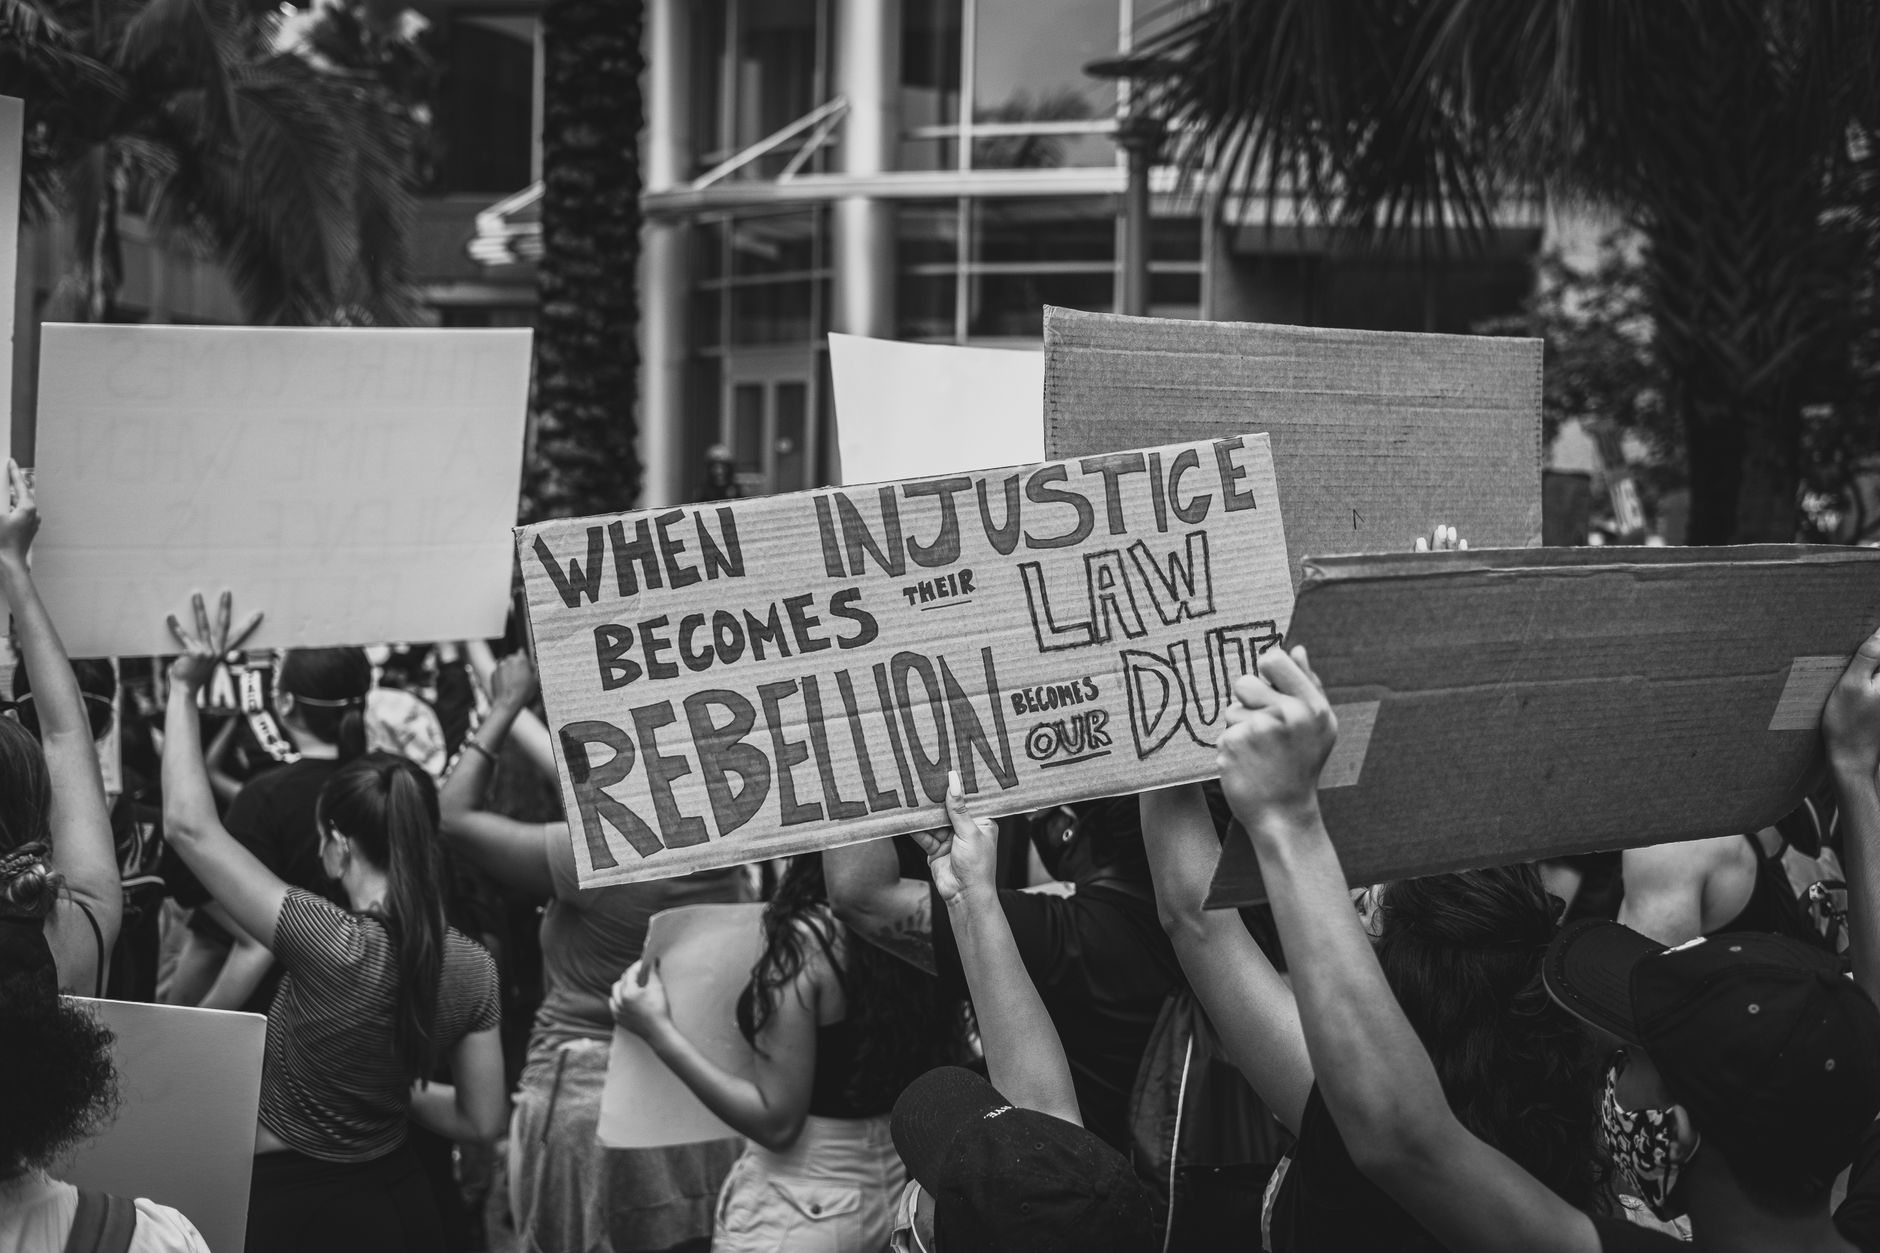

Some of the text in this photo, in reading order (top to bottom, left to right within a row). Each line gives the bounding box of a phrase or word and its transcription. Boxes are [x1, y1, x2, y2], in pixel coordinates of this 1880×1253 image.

[532, 437, 1256, 608] WHEN INJUSTICE
[594, 530, 1217, 691] BECOMES THEIR LAW
[559, 647, 1019, 871] REBELLION
[1011, 676, 1099, 716] BECOMES
[1025, 709, 1112, 760] OUR
[1120, 620, 1283, 761] DUT
